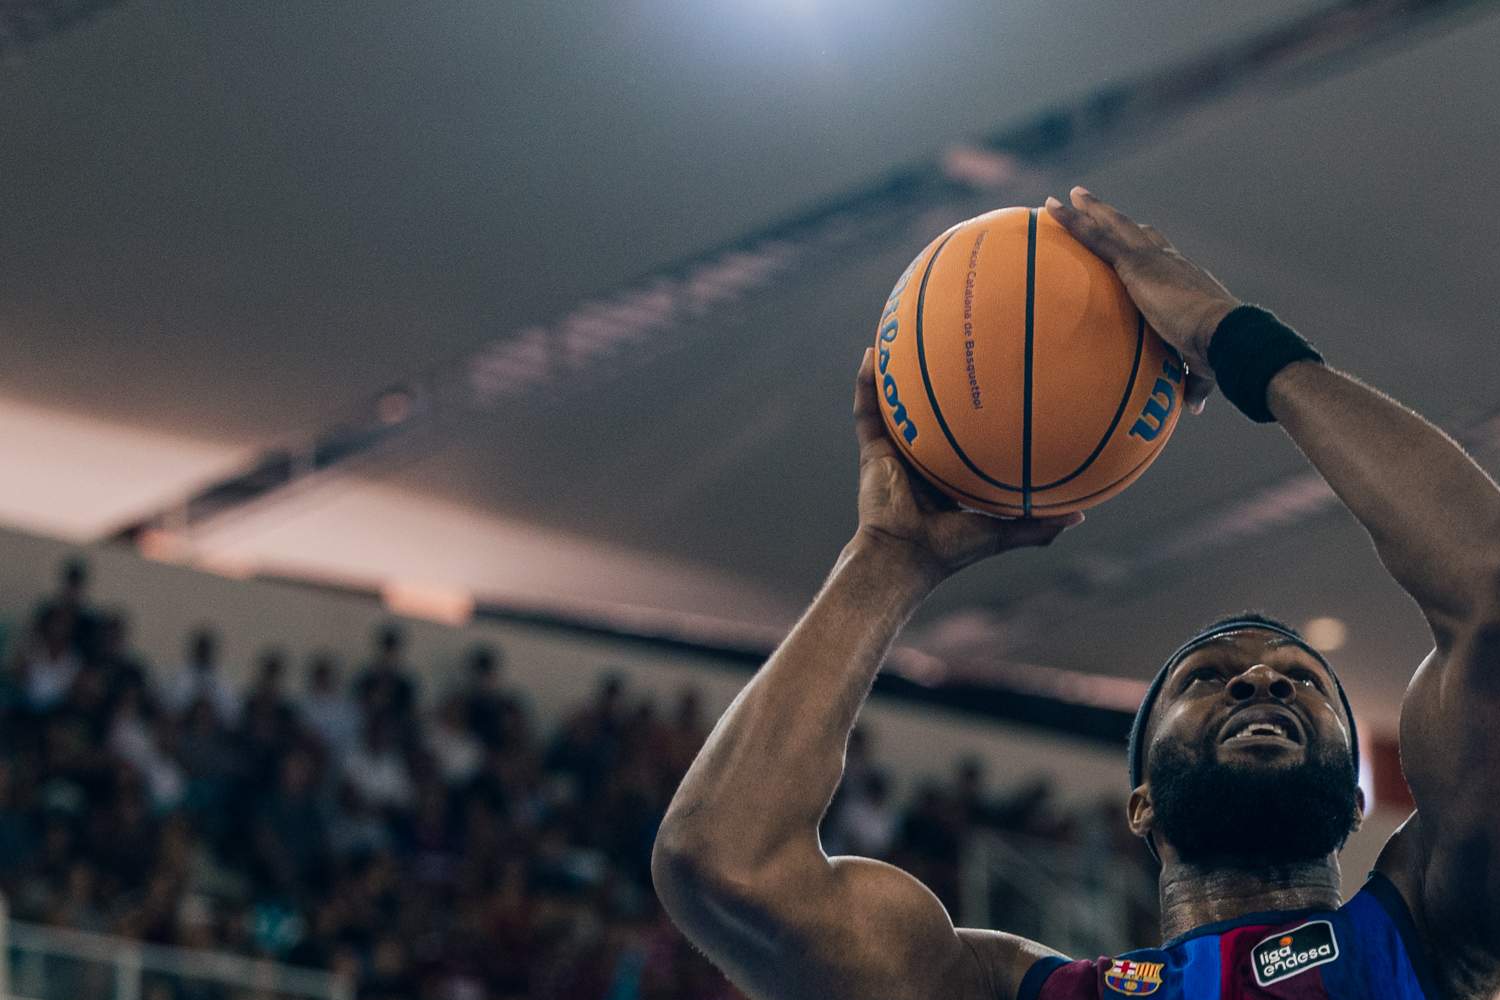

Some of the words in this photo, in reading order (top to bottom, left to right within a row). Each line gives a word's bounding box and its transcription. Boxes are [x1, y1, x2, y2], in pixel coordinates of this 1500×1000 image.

[964, 271, 977, 320] Catalana
[964, 322, 974, 338] de
[964, 340, 983, 410] Basquetbol
[1260, 945, 1291, 965] liga
[1263, 944, 1331, 977] endesa
